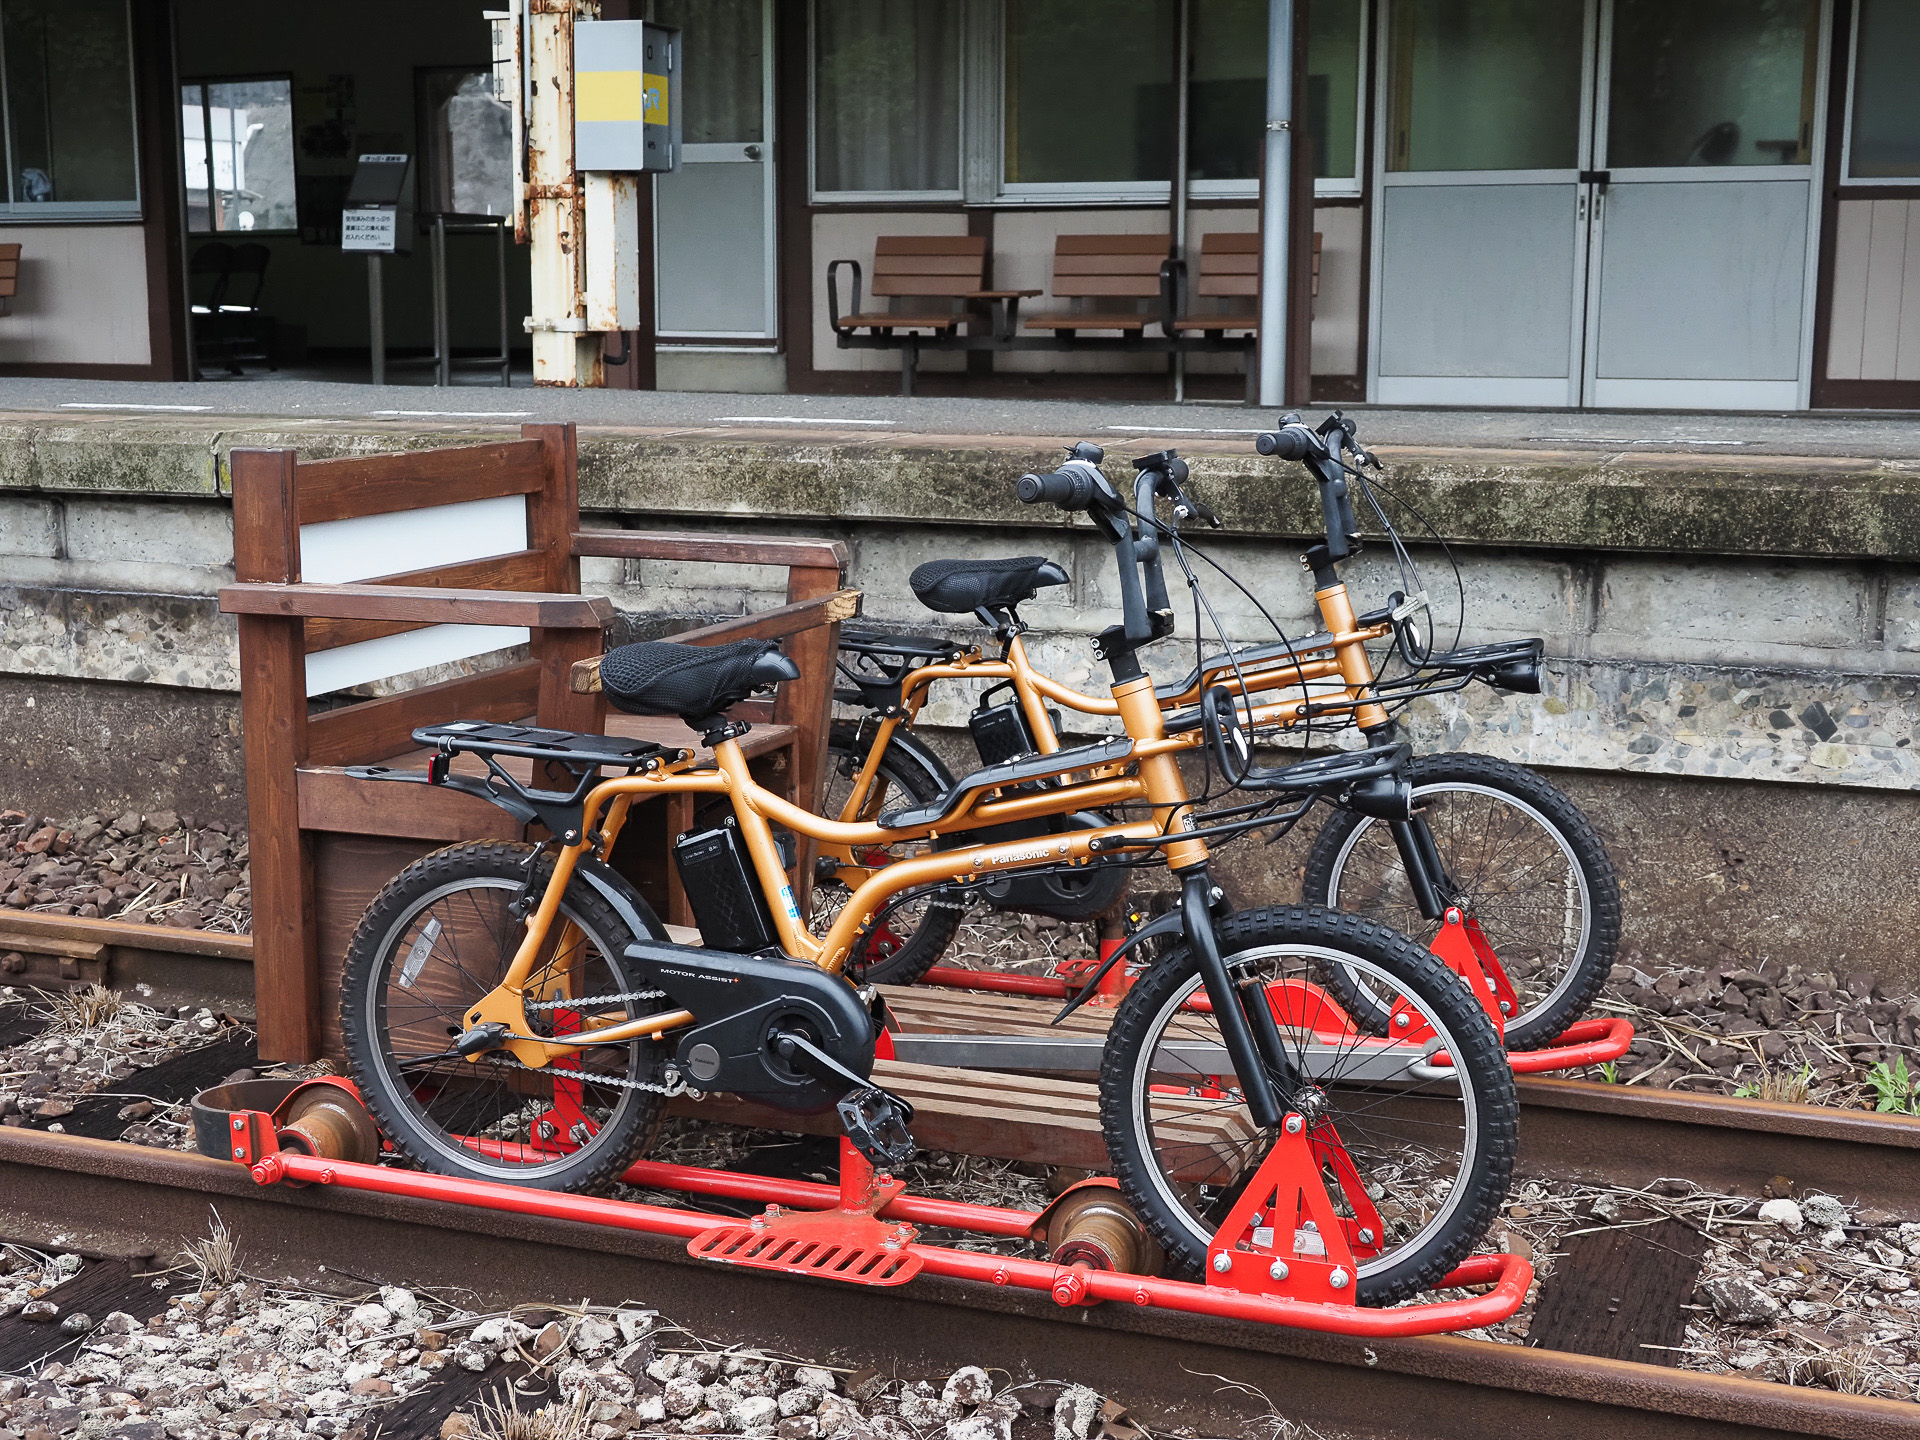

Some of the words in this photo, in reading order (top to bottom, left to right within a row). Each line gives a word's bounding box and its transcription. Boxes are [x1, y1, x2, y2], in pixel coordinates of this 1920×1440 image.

[644, 87, 660, 110] JR
[990, 849, 1050, 865] Panasonic
[660, 968, 696, 978] MOTOR
